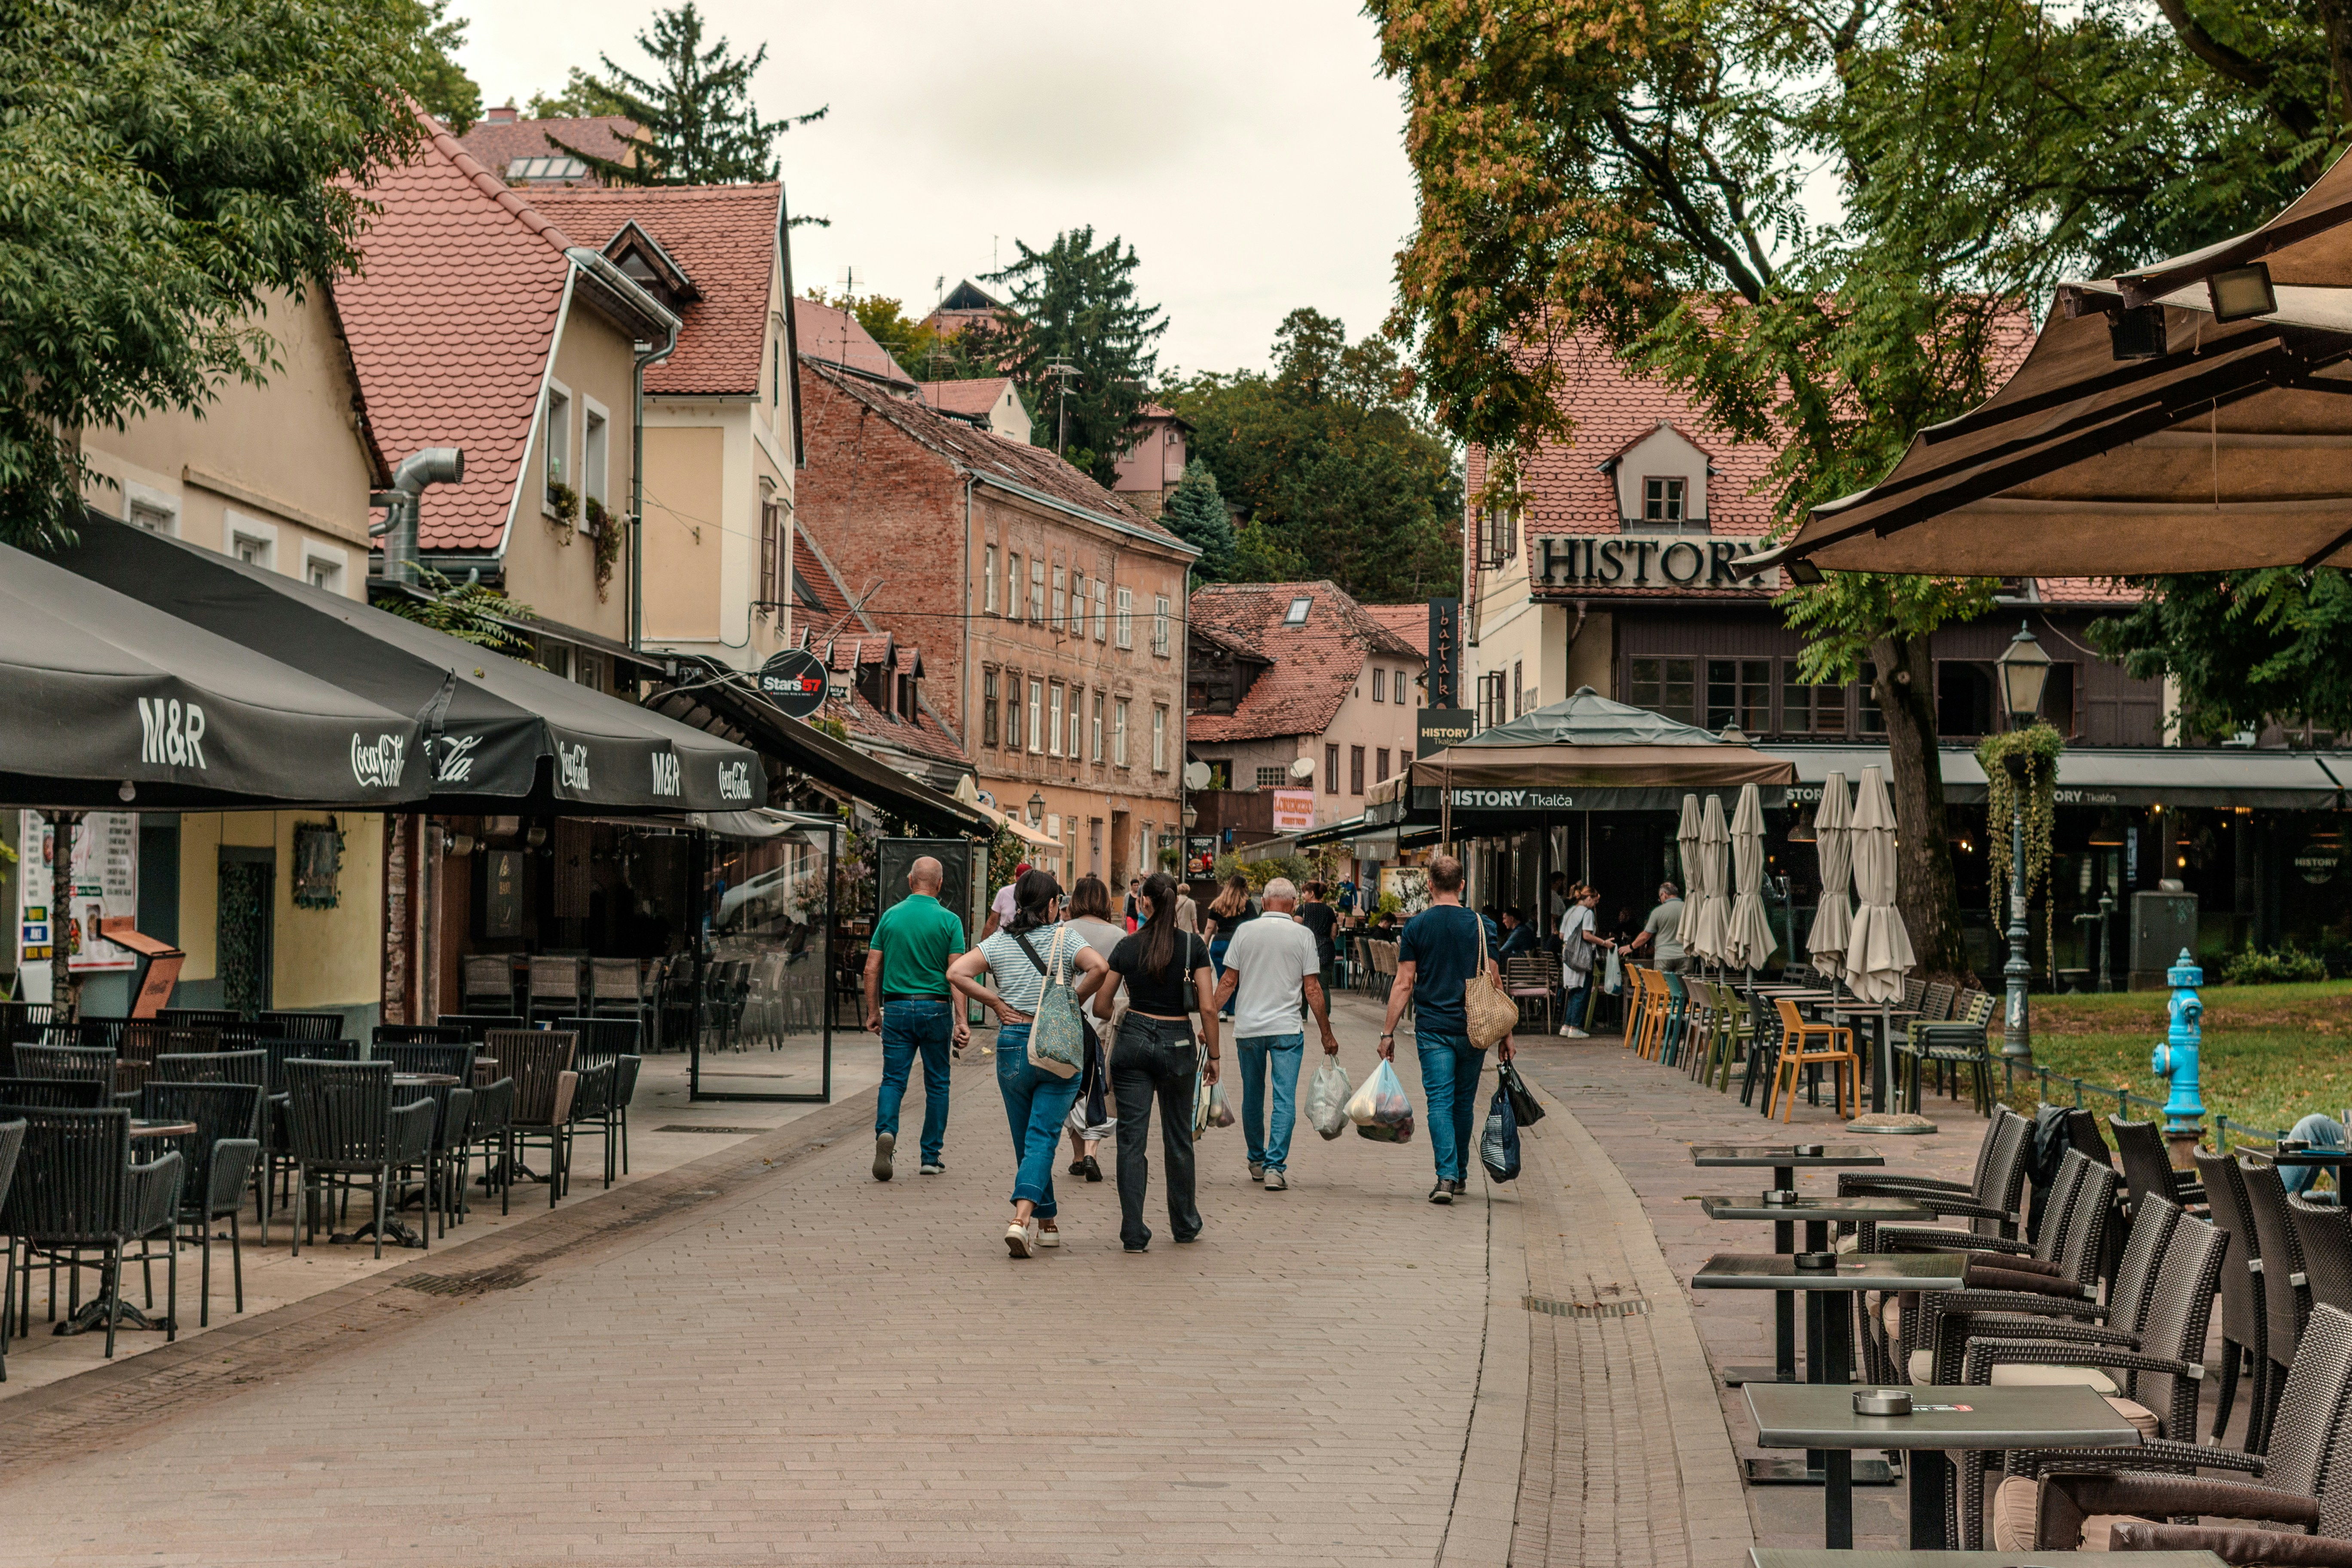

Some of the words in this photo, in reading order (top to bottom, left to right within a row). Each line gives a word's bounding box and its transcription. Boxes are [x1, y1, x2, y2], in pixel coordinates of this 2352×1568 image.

[1437, 606, 1451, 695] batak
[138, 697, 206, 769] M&R
[1422, 728, 1469, 738] HISTORY
[560, 741, 590, 790] Coca-Cola
[652, 753, 680, 796] M&R
[719, 761, 752, 800] Coca-Cola
[1529, 793, 1572, 807] Tkalča
